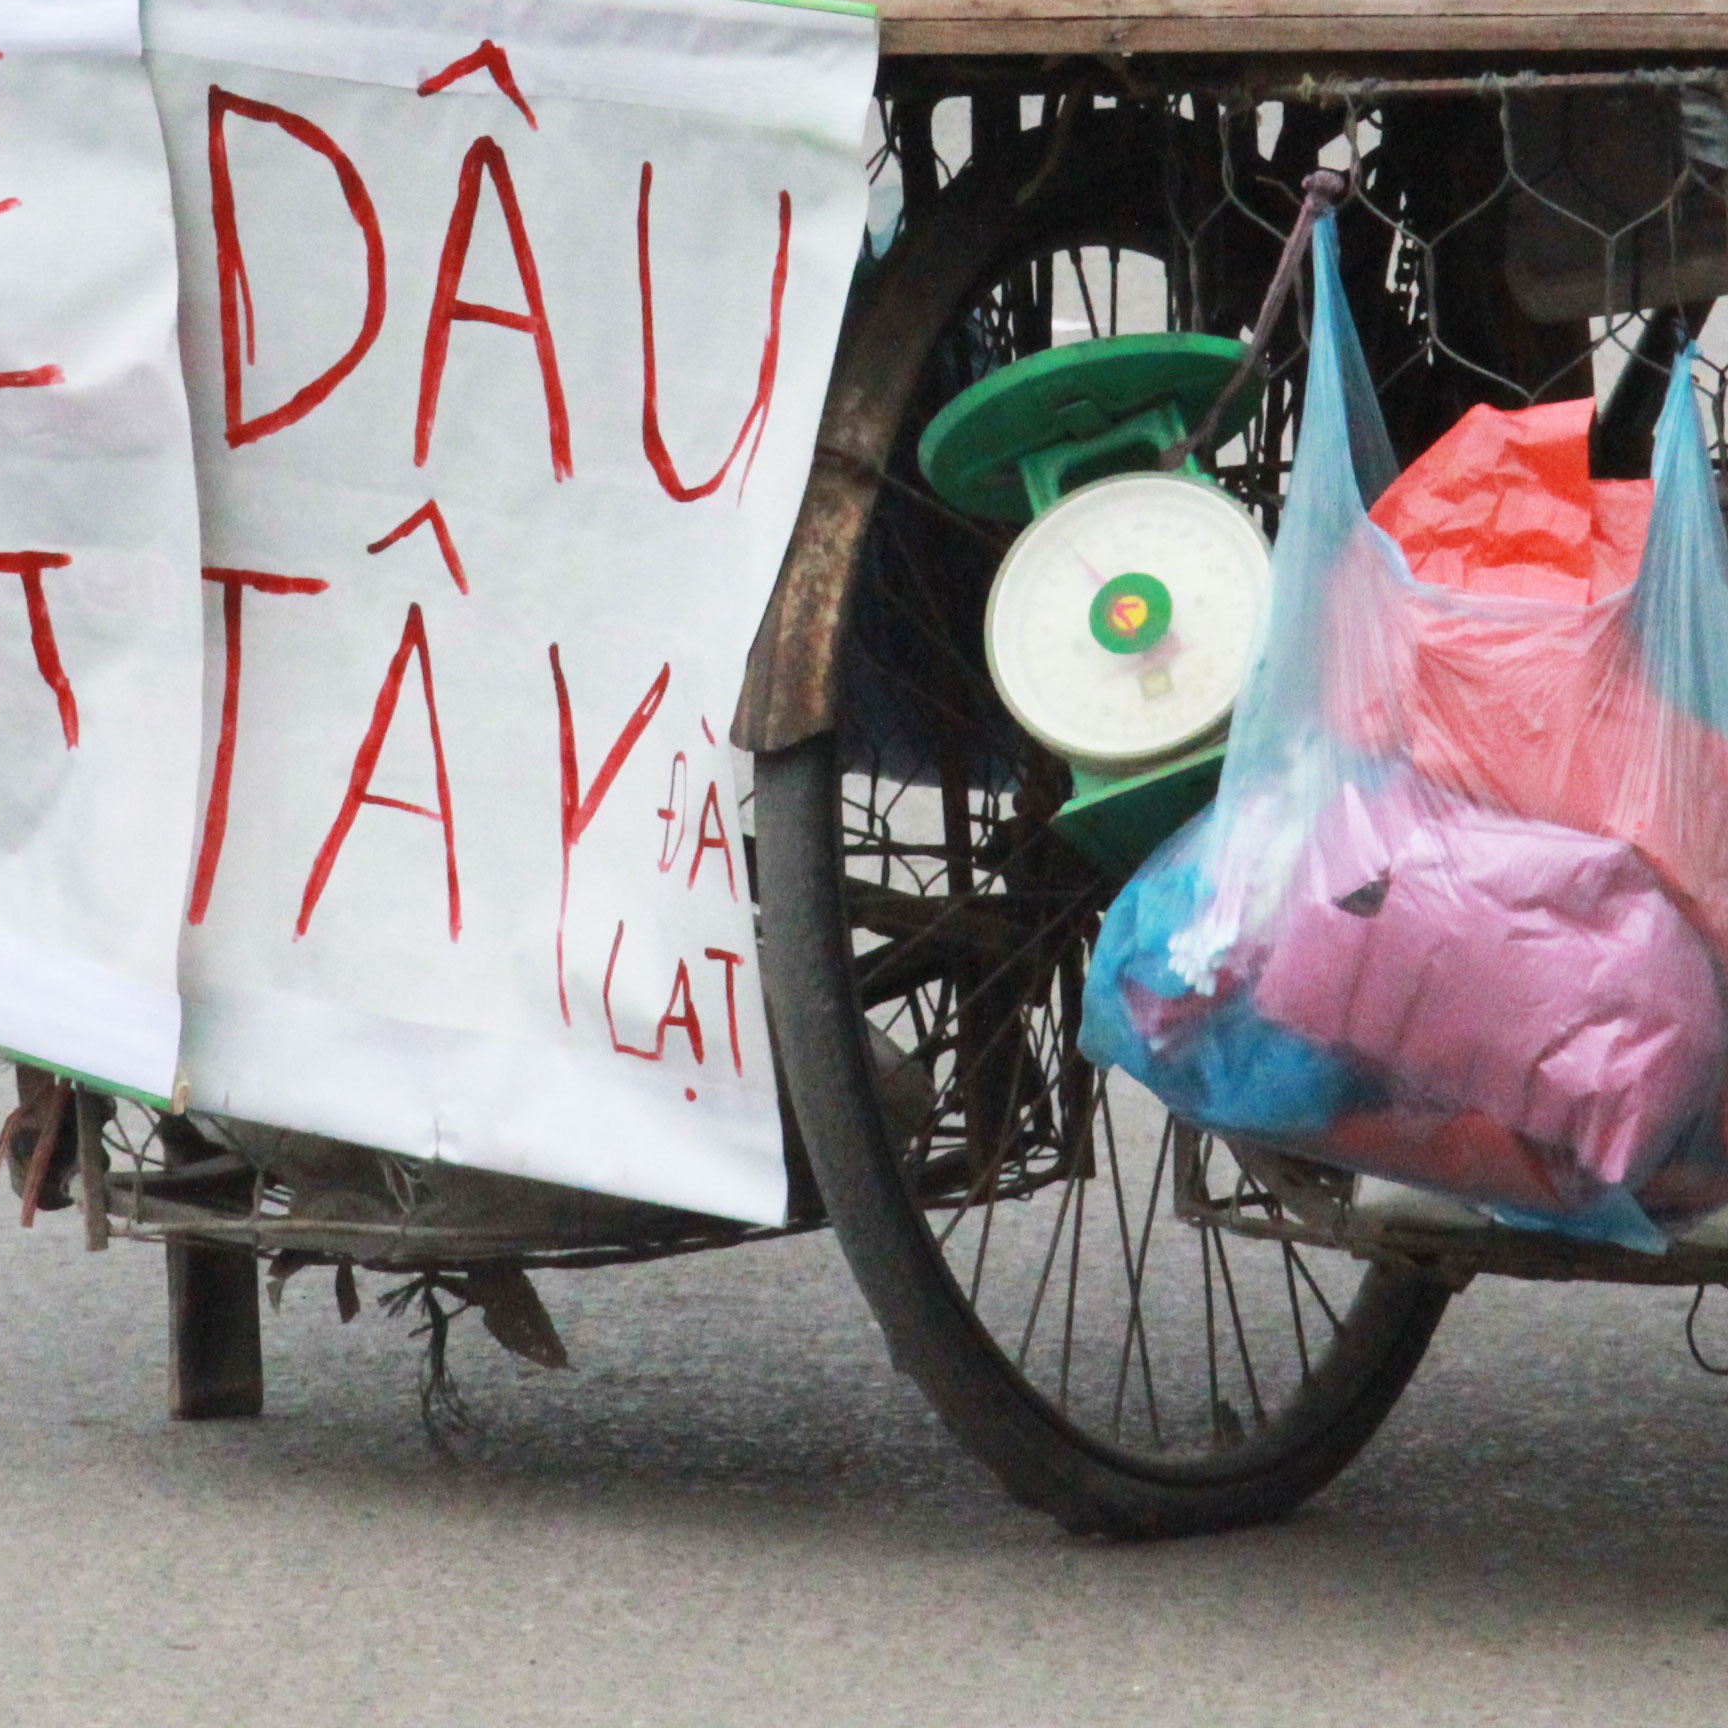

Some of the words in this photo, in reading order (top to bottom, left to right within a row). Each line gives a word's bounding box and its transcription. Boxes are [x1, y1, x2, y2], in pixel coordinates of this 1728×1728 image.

[207, 38, 793, 506] DÂU
[186, 497, 672, 1028] TÂY
[656, 713, 739, 904] ĐÀ
[603, 919, 747, 1103] LẠT
